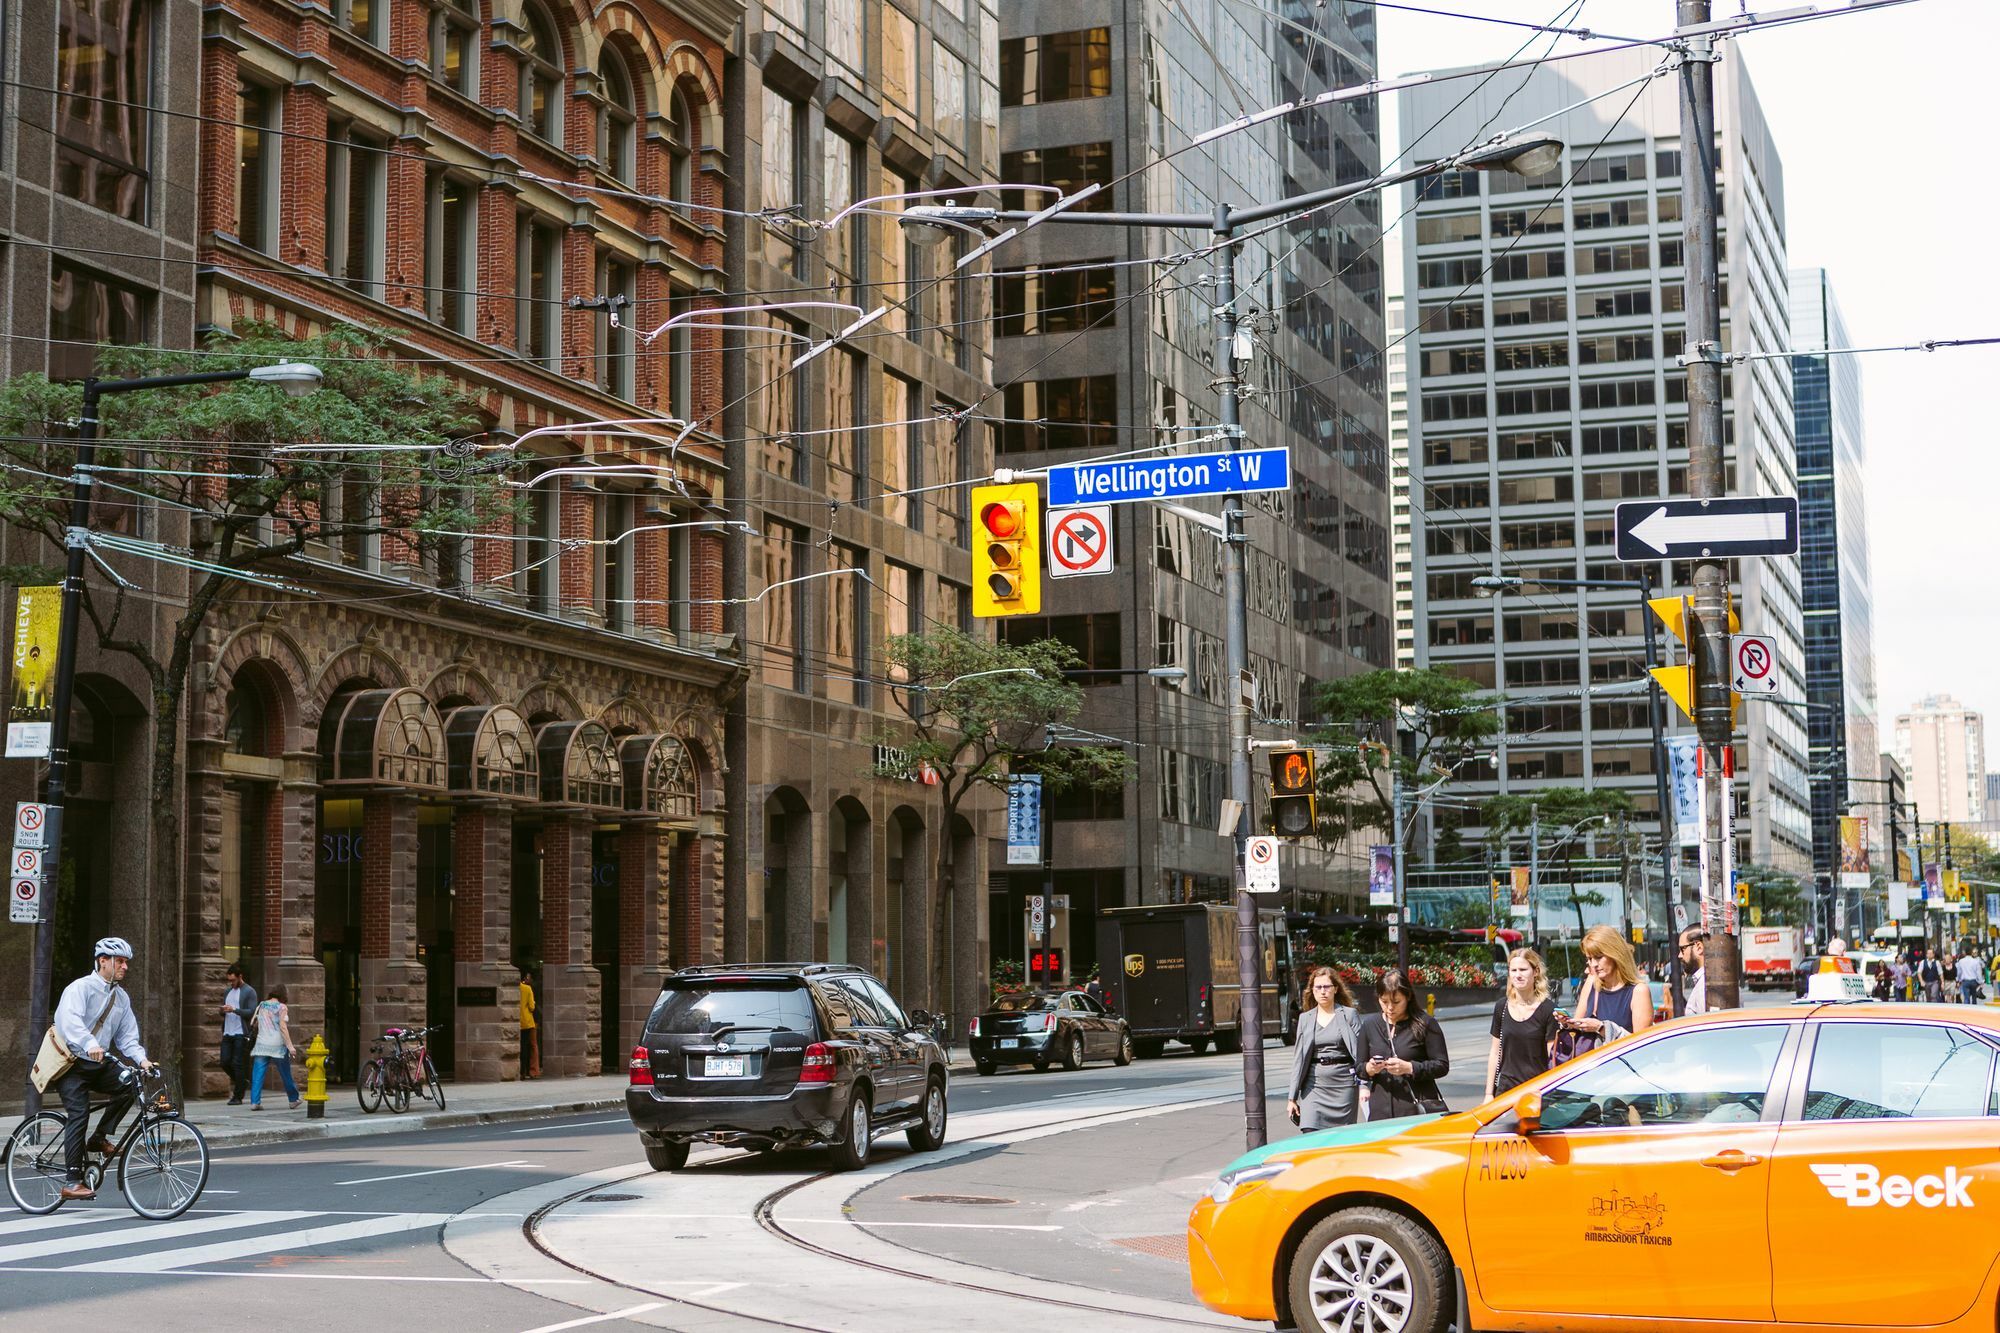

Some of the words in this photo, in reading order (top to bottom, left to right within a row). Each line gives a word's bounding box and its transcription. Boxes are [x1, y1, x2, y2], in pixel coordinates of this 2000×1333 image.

[1074, 462, 1210, 496] Wellington
[1217, 458, 1231, 473] St
[1239, 455, 1261, 482] W
[15, 595, 33, 668] ACHIEVE
[1127, 960, 1143, 974] ups
[706, 1061, 724, 1071] BJHT
[728, 1060, 742, 1071] 578
[1847, 1163, 1975, 1208] Beck
[1585, 1231, 1638, 1244] AMBASSADOR
[1640, 1234, 1673, 1246] TAXICAB
